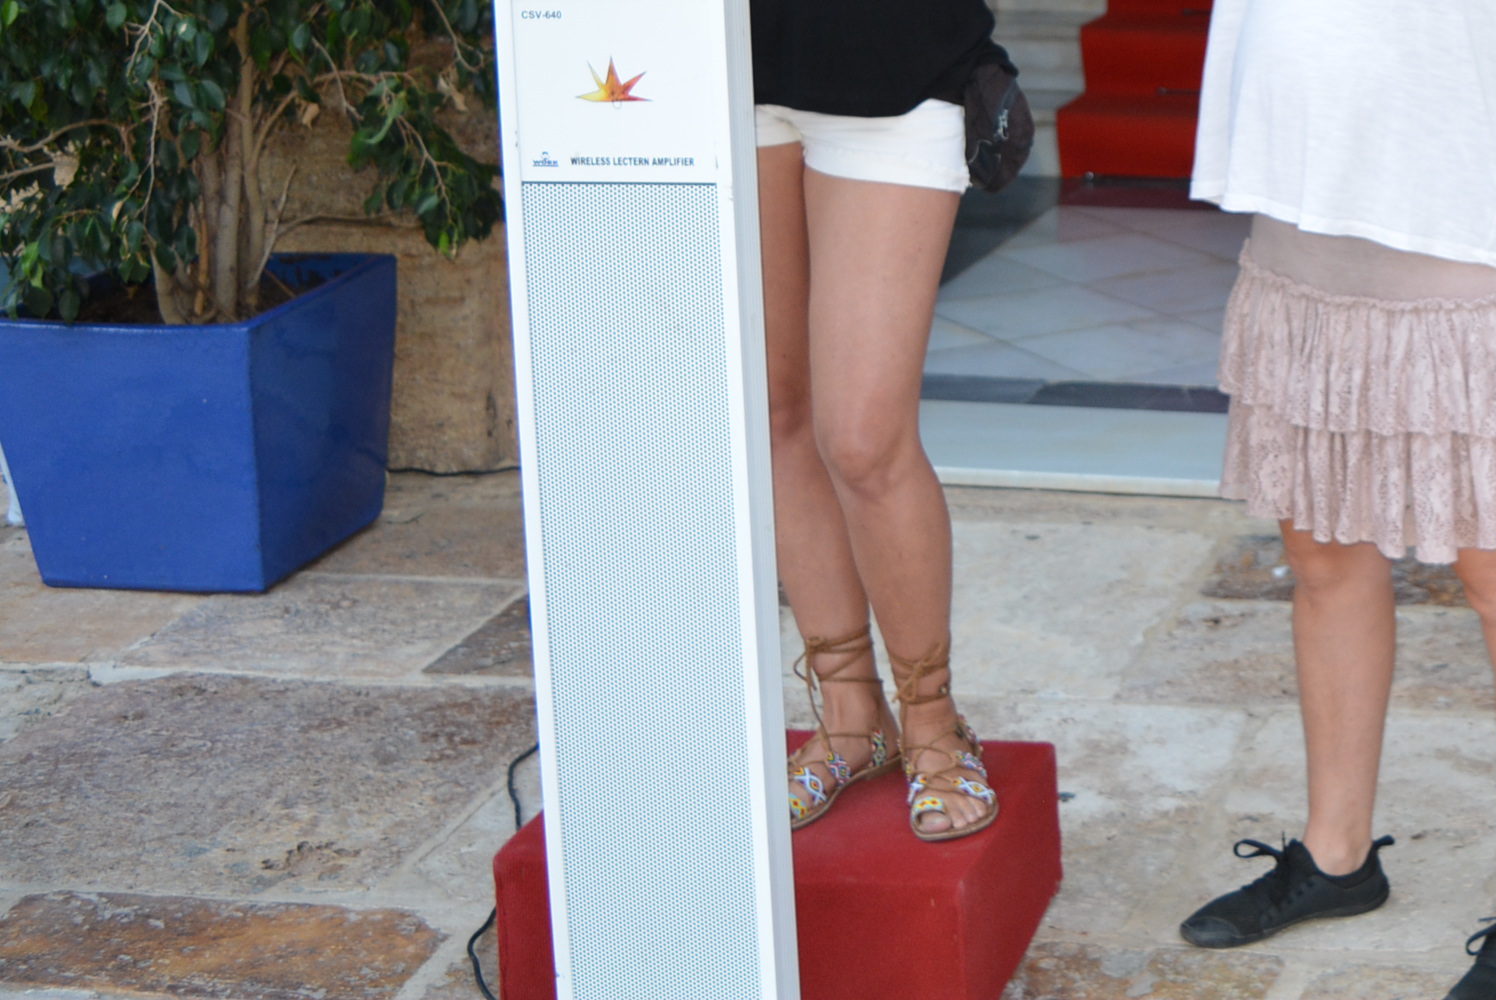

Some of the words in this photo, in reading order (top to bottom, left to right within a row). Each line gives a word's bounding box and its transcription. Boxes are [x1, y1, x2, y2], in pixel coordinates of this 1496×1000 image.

[521, 9, 562, 20] CSV-640
[570, 156, 611, 166] WIRELESS
[612, 157, 650, 166] LECTERN
[651, 157, 695, 167] AMPLIFIER
